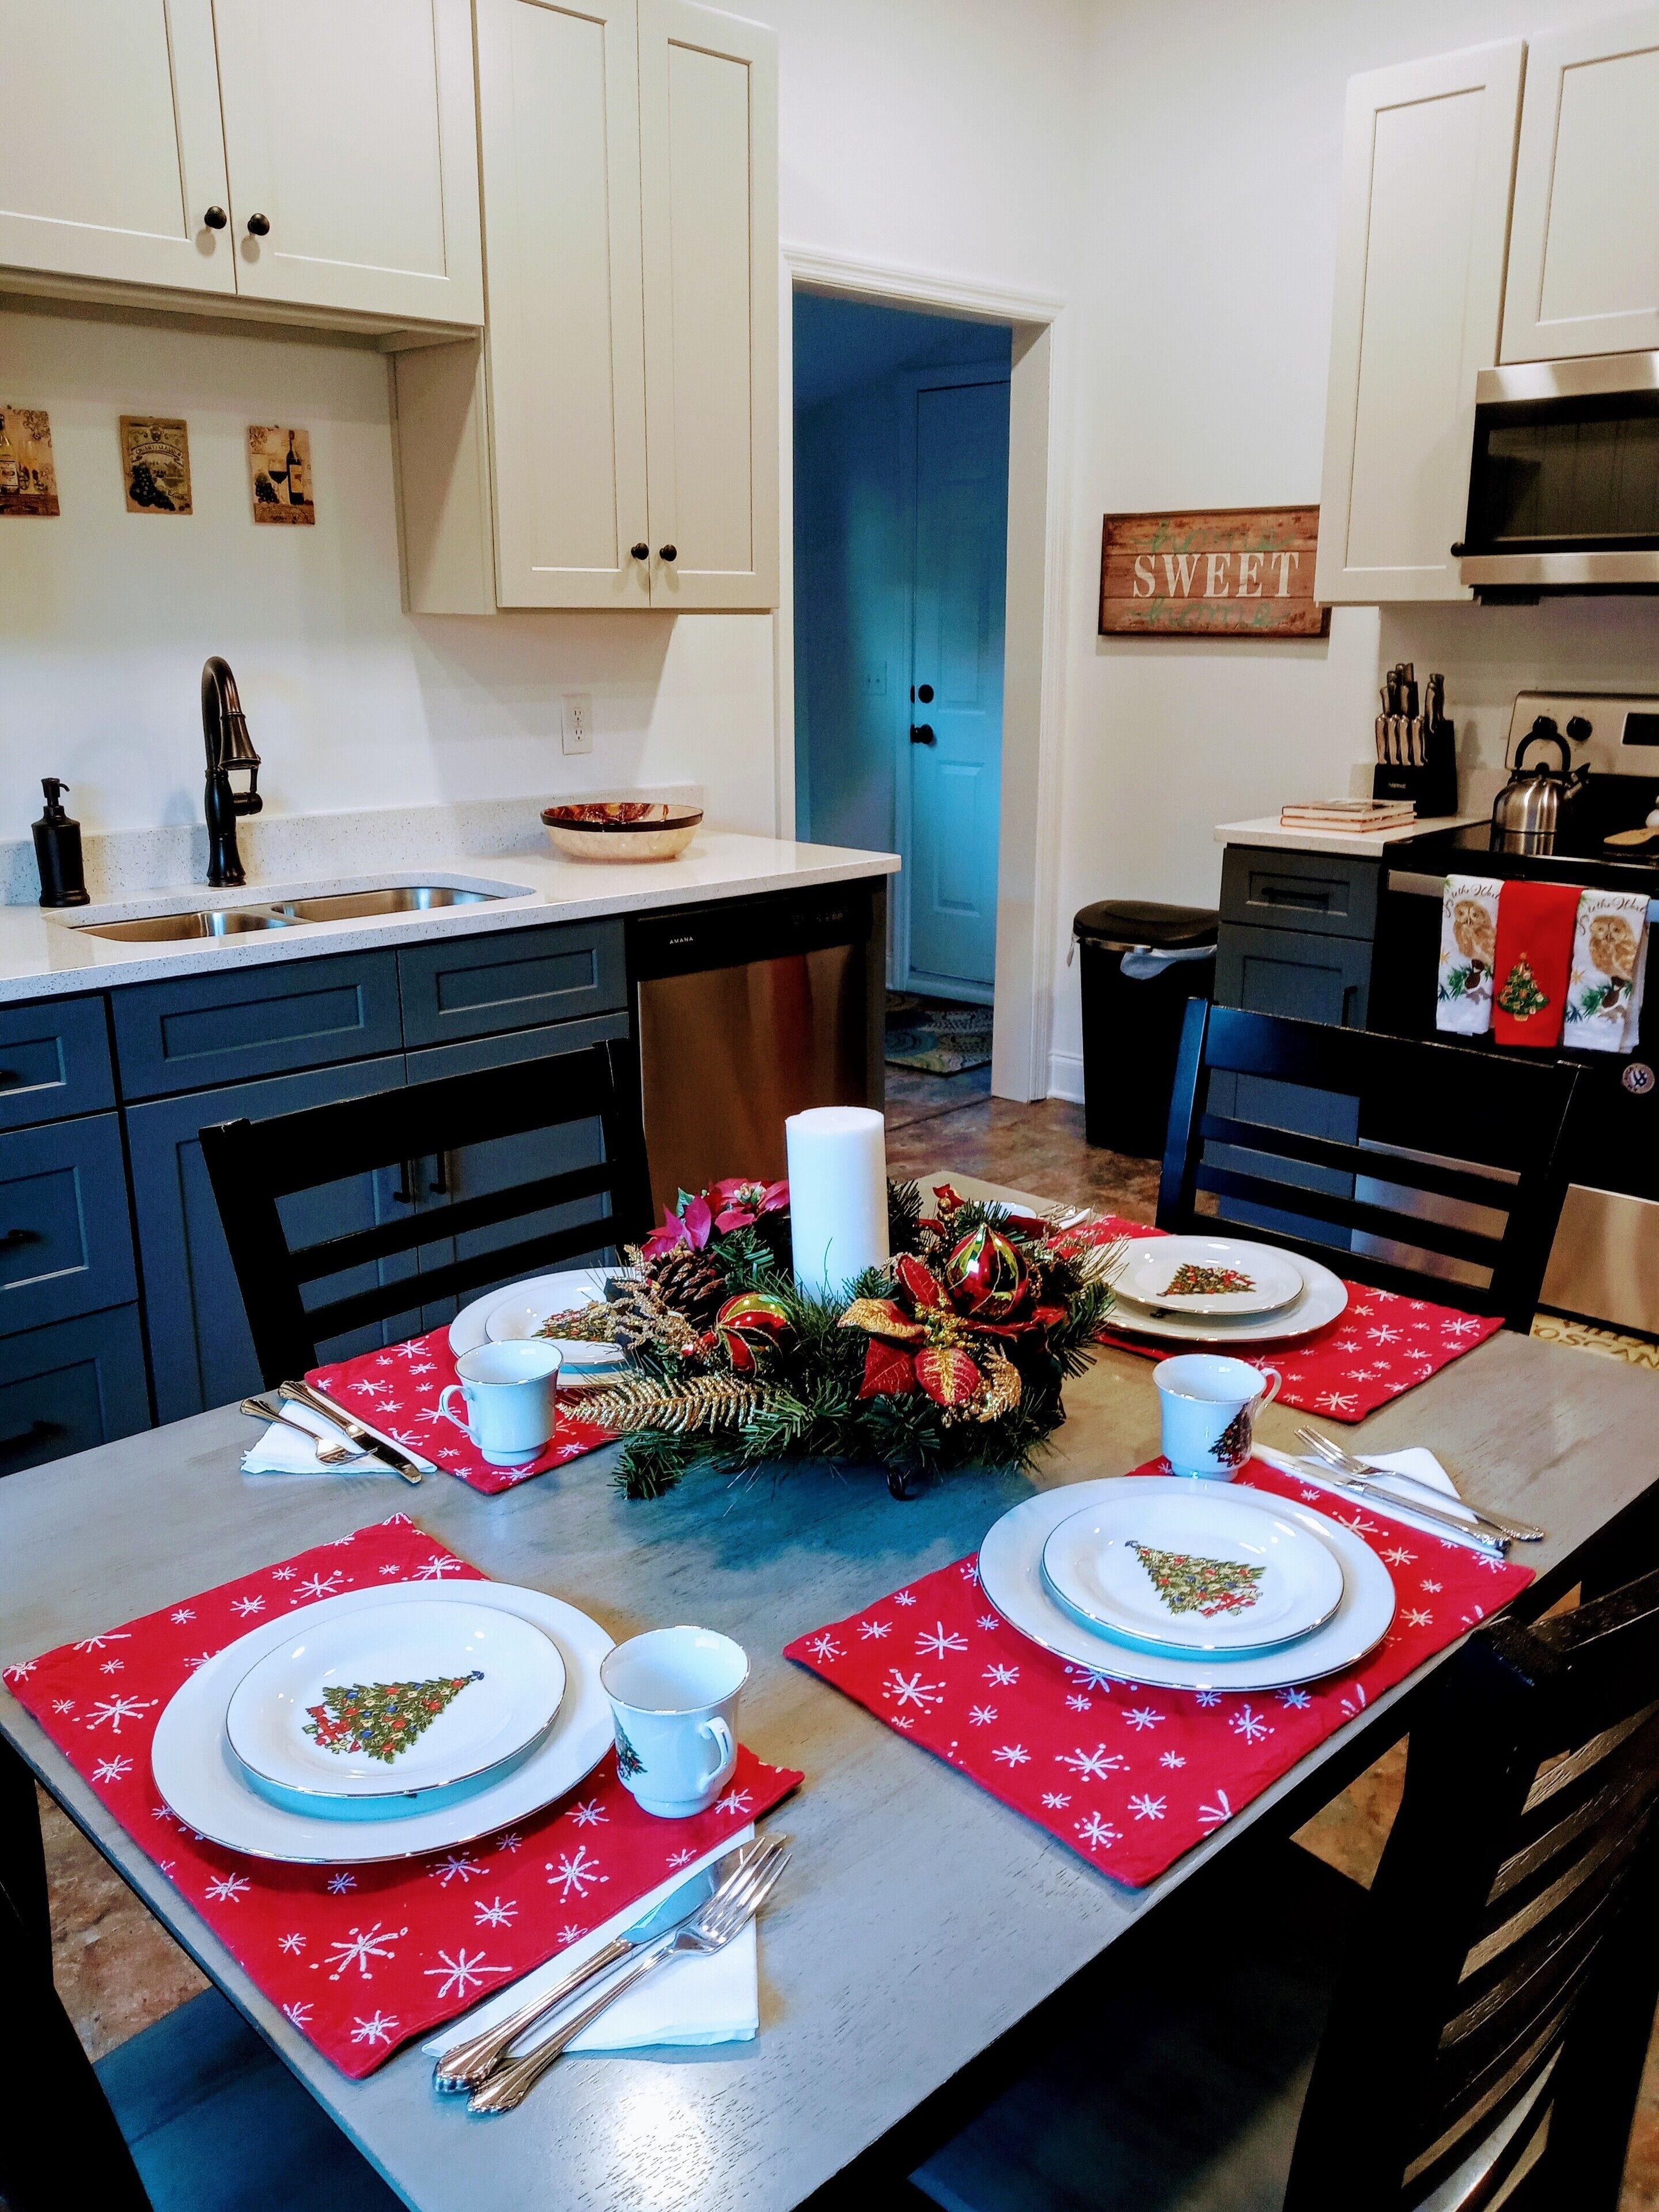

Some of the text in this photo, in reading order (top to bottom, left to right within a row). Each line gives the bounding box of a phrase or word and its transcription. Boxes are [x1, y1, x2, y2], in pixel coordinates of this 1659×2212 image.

[1132, 520, 1293, 553] home
[1132, 552, 1299, 598] SWEET
[1127, 594, 1289, 626] home
[669, 936, 694, 945] AMANA
